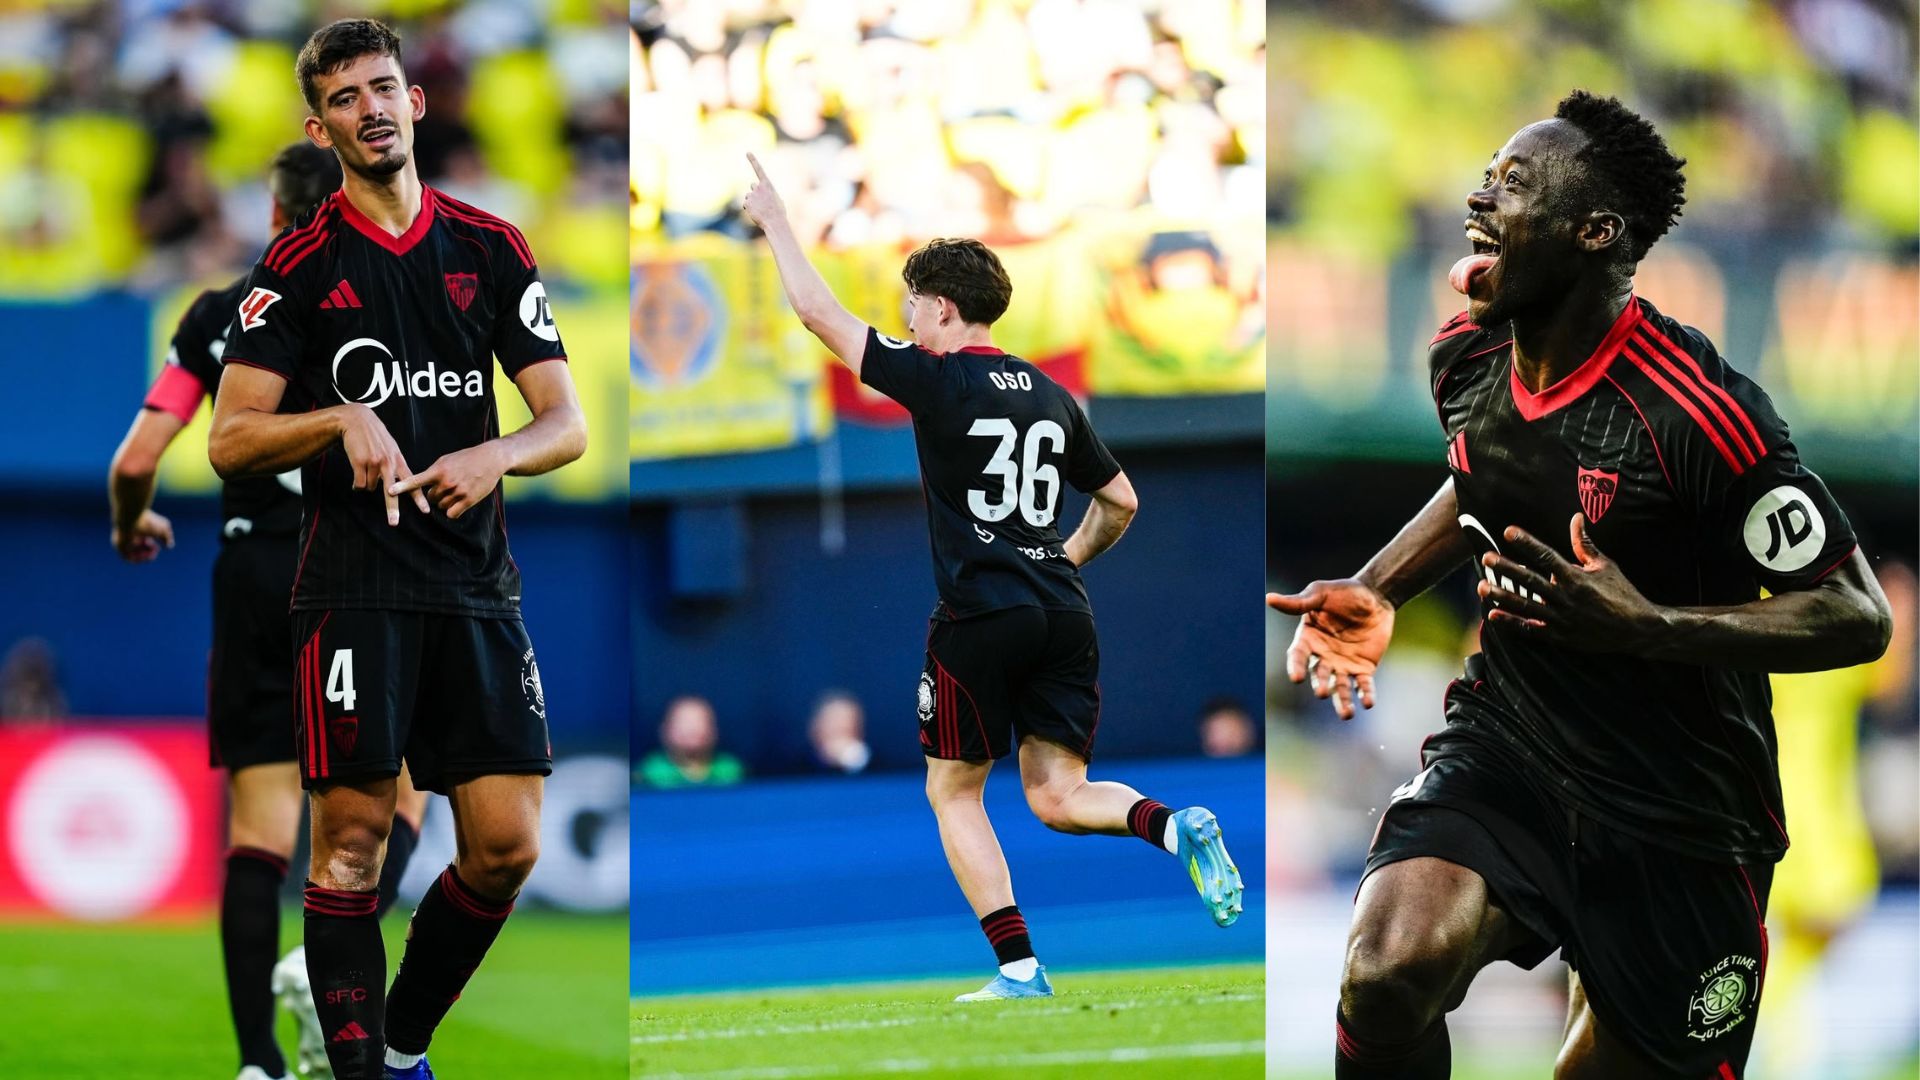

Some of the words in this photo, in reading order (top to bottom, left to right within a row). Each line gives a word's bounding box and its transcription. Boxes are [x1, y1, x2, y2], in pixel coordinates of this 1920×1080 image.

[354, 360, 484, 409] Midea
[988, 371, 1033, 391] OSO
[966, 418, 1065, 527] 36
[1765, 499, 1813, 562] JD
[326, 648, 356, 711] 4
[1700, 957, 1730, 983] JUICE
[1731, 954, 1756, 970] TIME
[325, 987, 367, 1004] SFC
